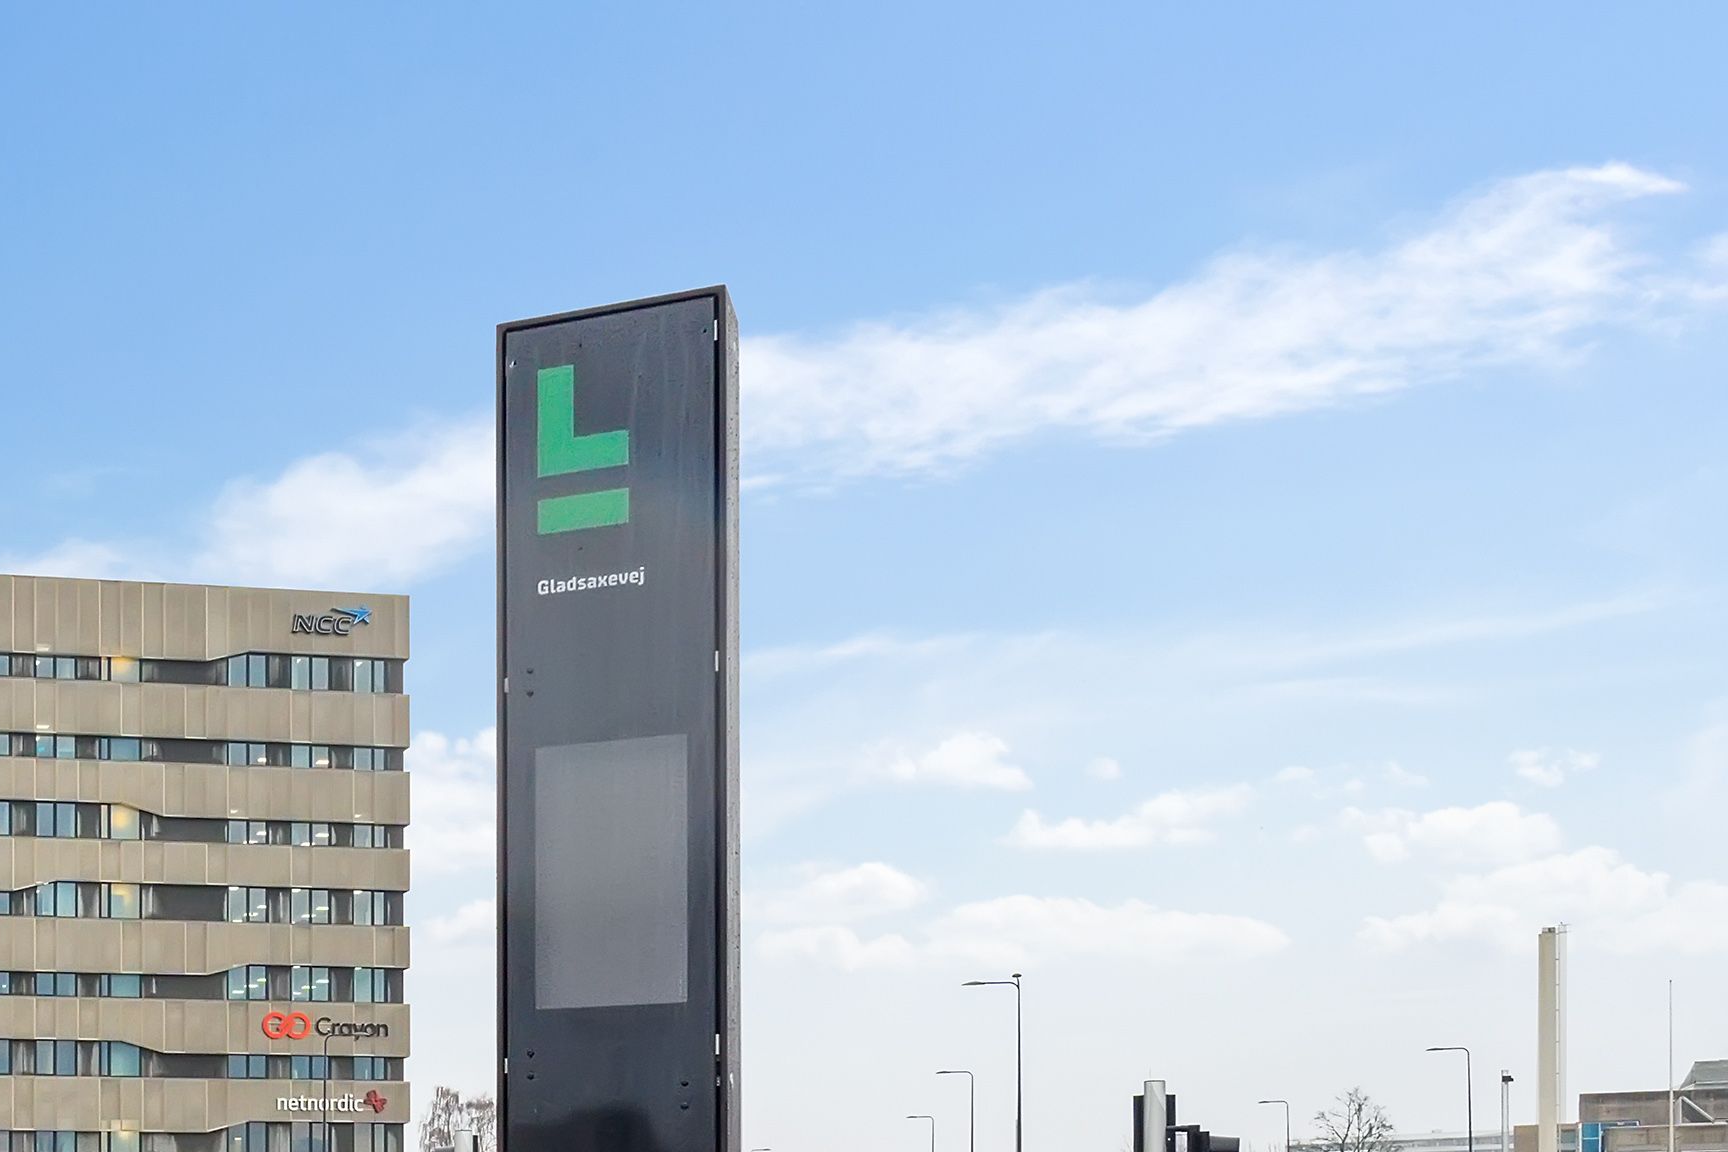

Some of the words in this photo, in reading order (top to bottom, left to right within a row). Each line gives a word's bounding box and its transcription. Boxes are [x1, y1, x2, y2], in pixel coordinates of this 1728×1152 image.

[537, 566, 645, 596] Gladsaxevej
[291, 613, 353, 636] NCC
[315, 1016, 389, 1042] Crayon
[276, 1093, 365, 1113] netnordic
